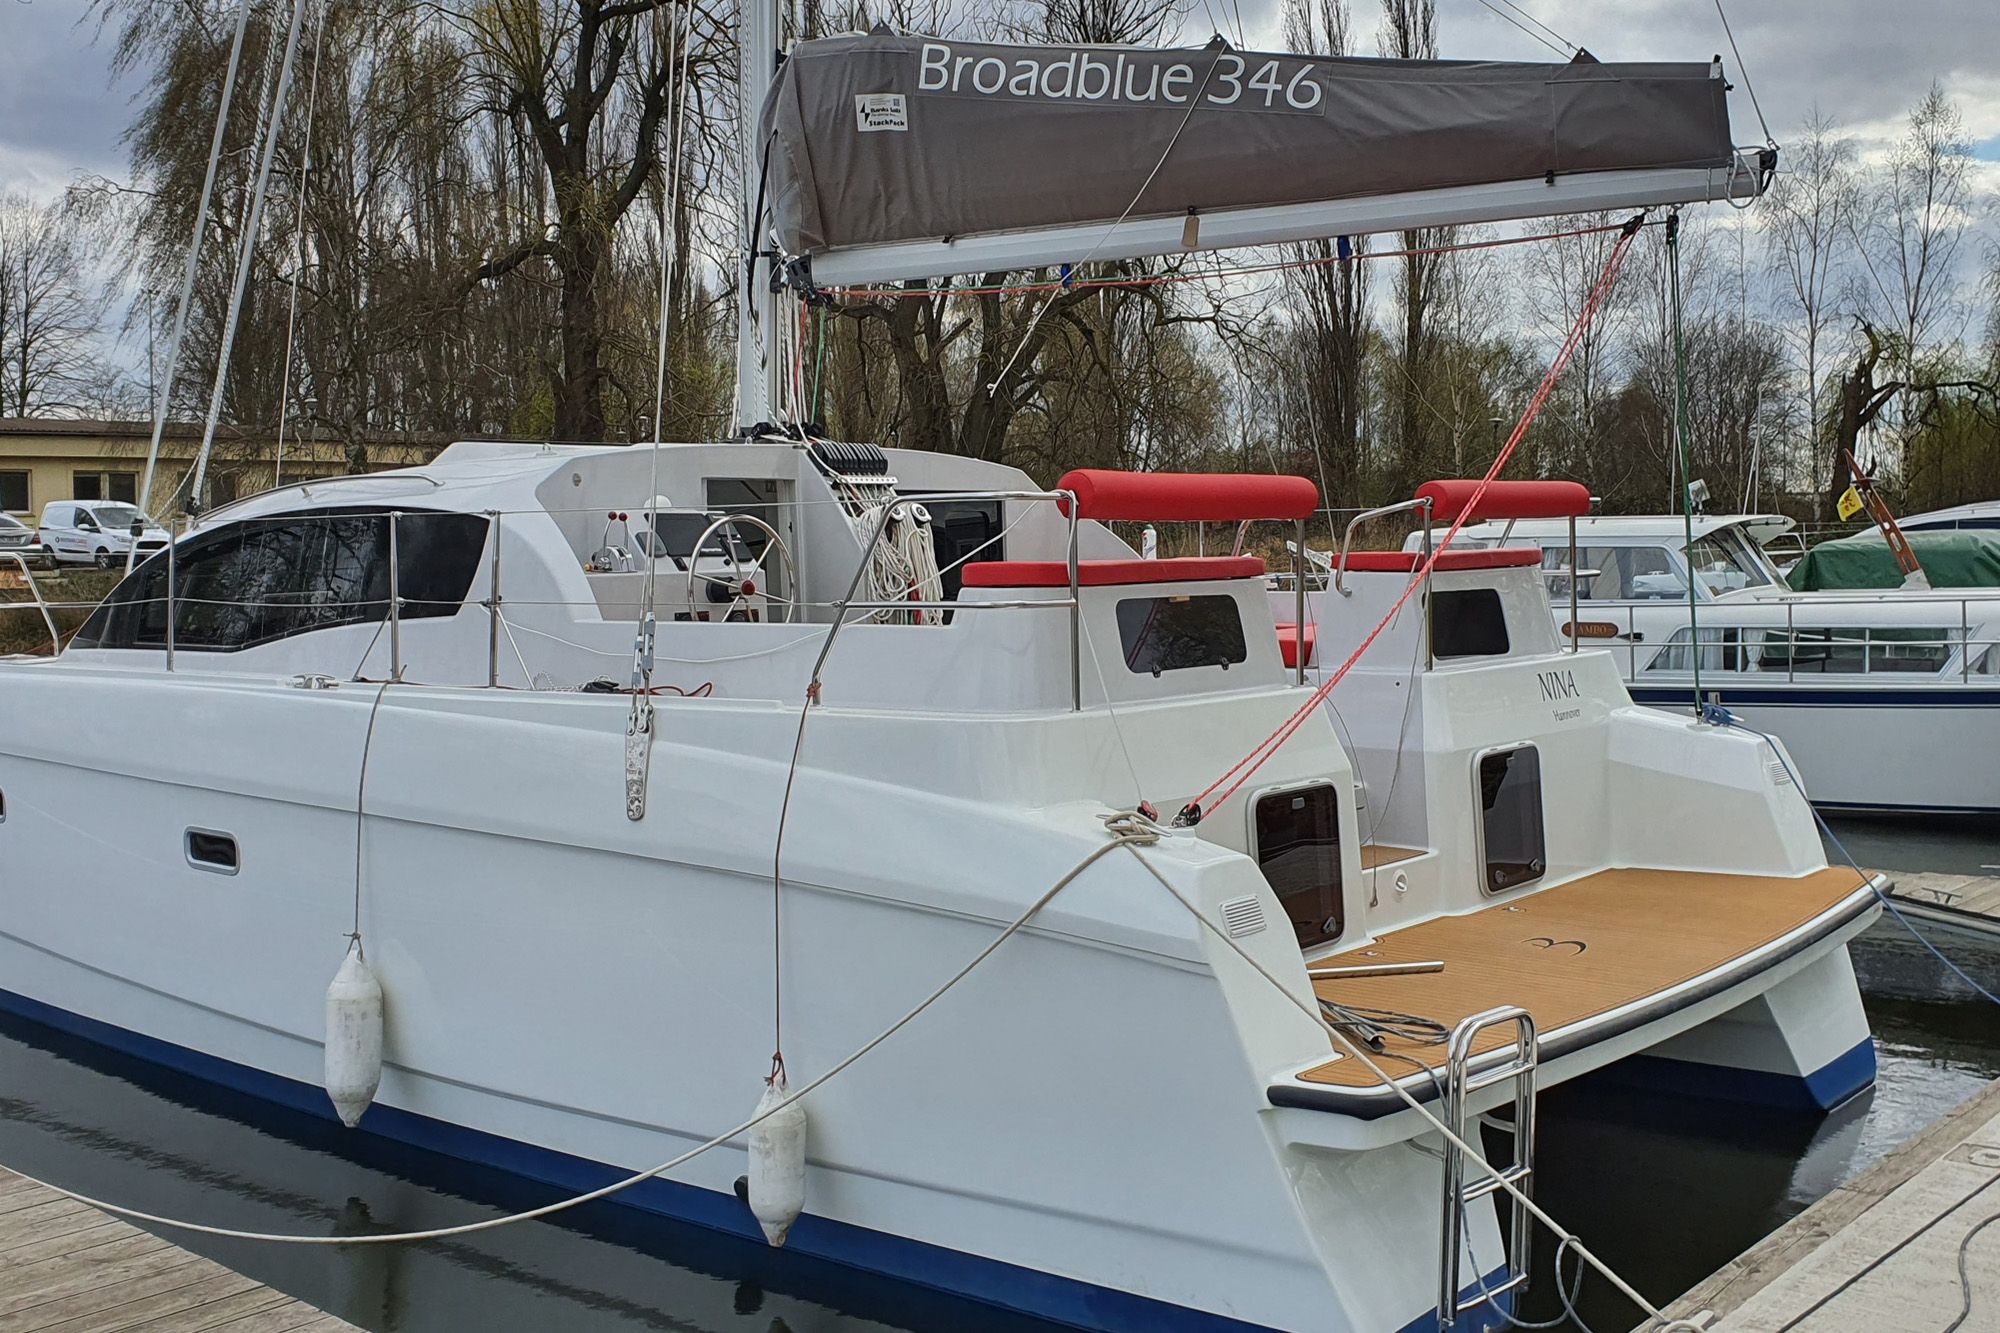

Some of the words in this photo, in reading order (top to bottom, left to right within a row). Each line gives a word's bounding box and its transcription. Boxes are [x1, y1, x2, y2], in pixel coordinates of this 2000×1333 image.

[918, 43, 1194, 103] Broadblue
[1207, 54, 1322, 109] 346
[1574, 624, 1608, 635] AMBO
[1537, 669, 1580, 702] NINA
[1552, 708, 1581, 722] Hannover
